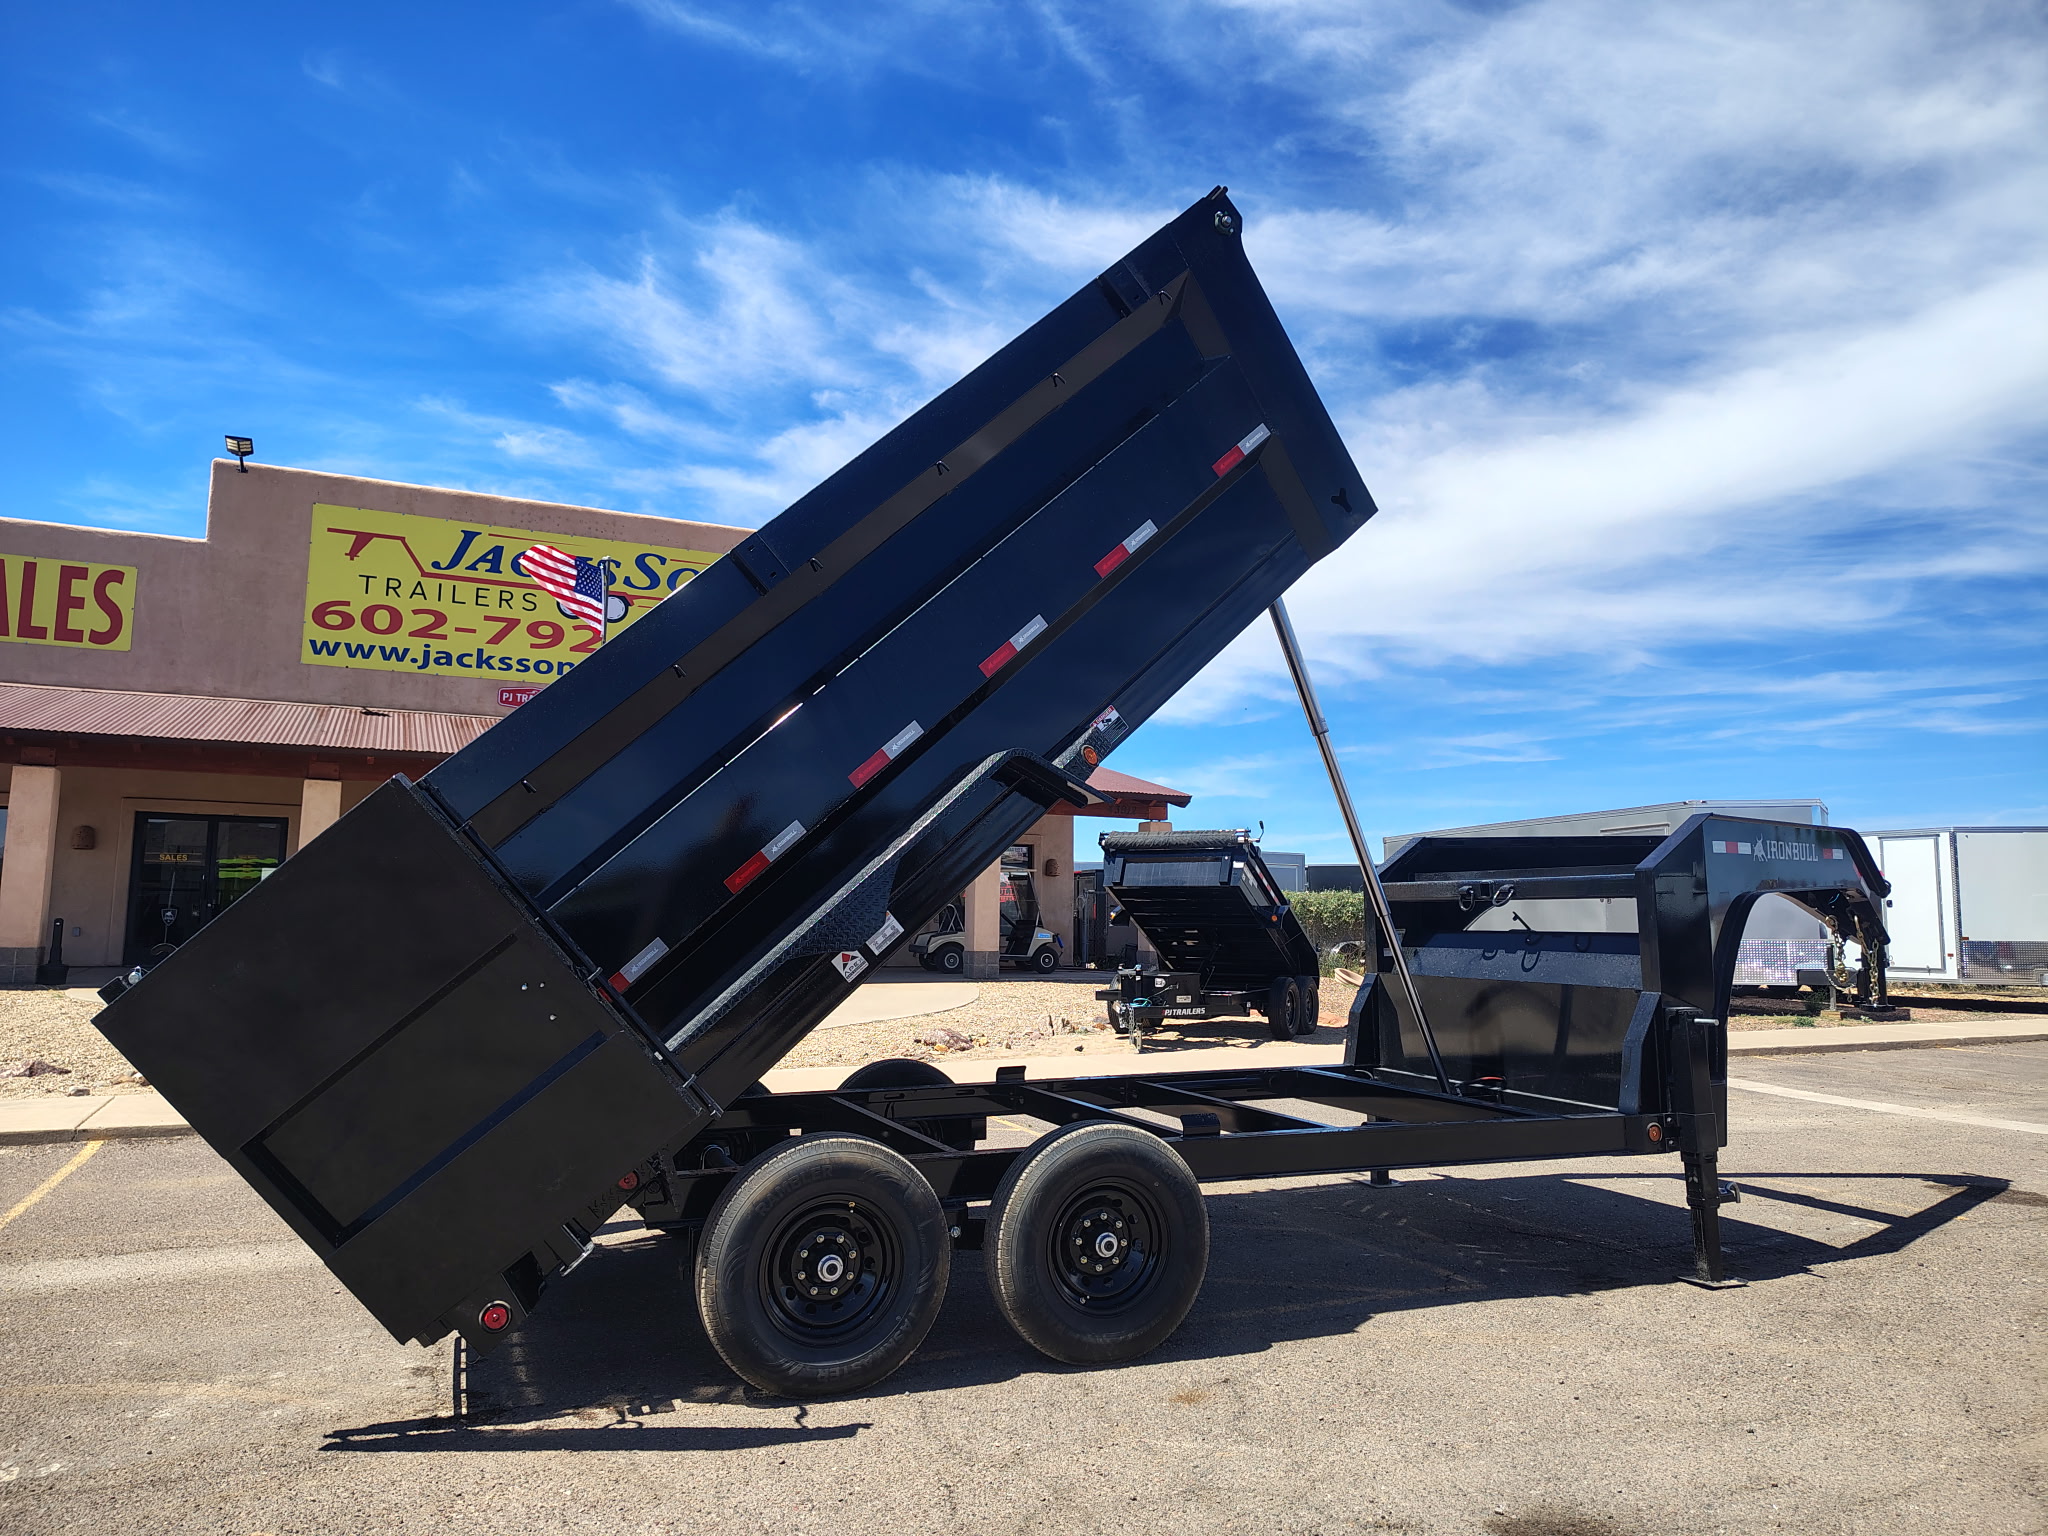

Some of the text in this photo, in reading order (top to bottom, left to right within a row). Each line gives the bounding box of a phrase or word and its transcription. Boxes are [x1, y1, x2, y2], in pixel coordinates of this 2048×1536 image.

[358, 574, 538, 612] TRAILERS
[502, 692, 513, 702] PJ
[1766, 840, 1819, 862] IRONBULL
[159, 853, 188, 862] SALES
[1172, 1007, 1206, 1016] TRAILERS
